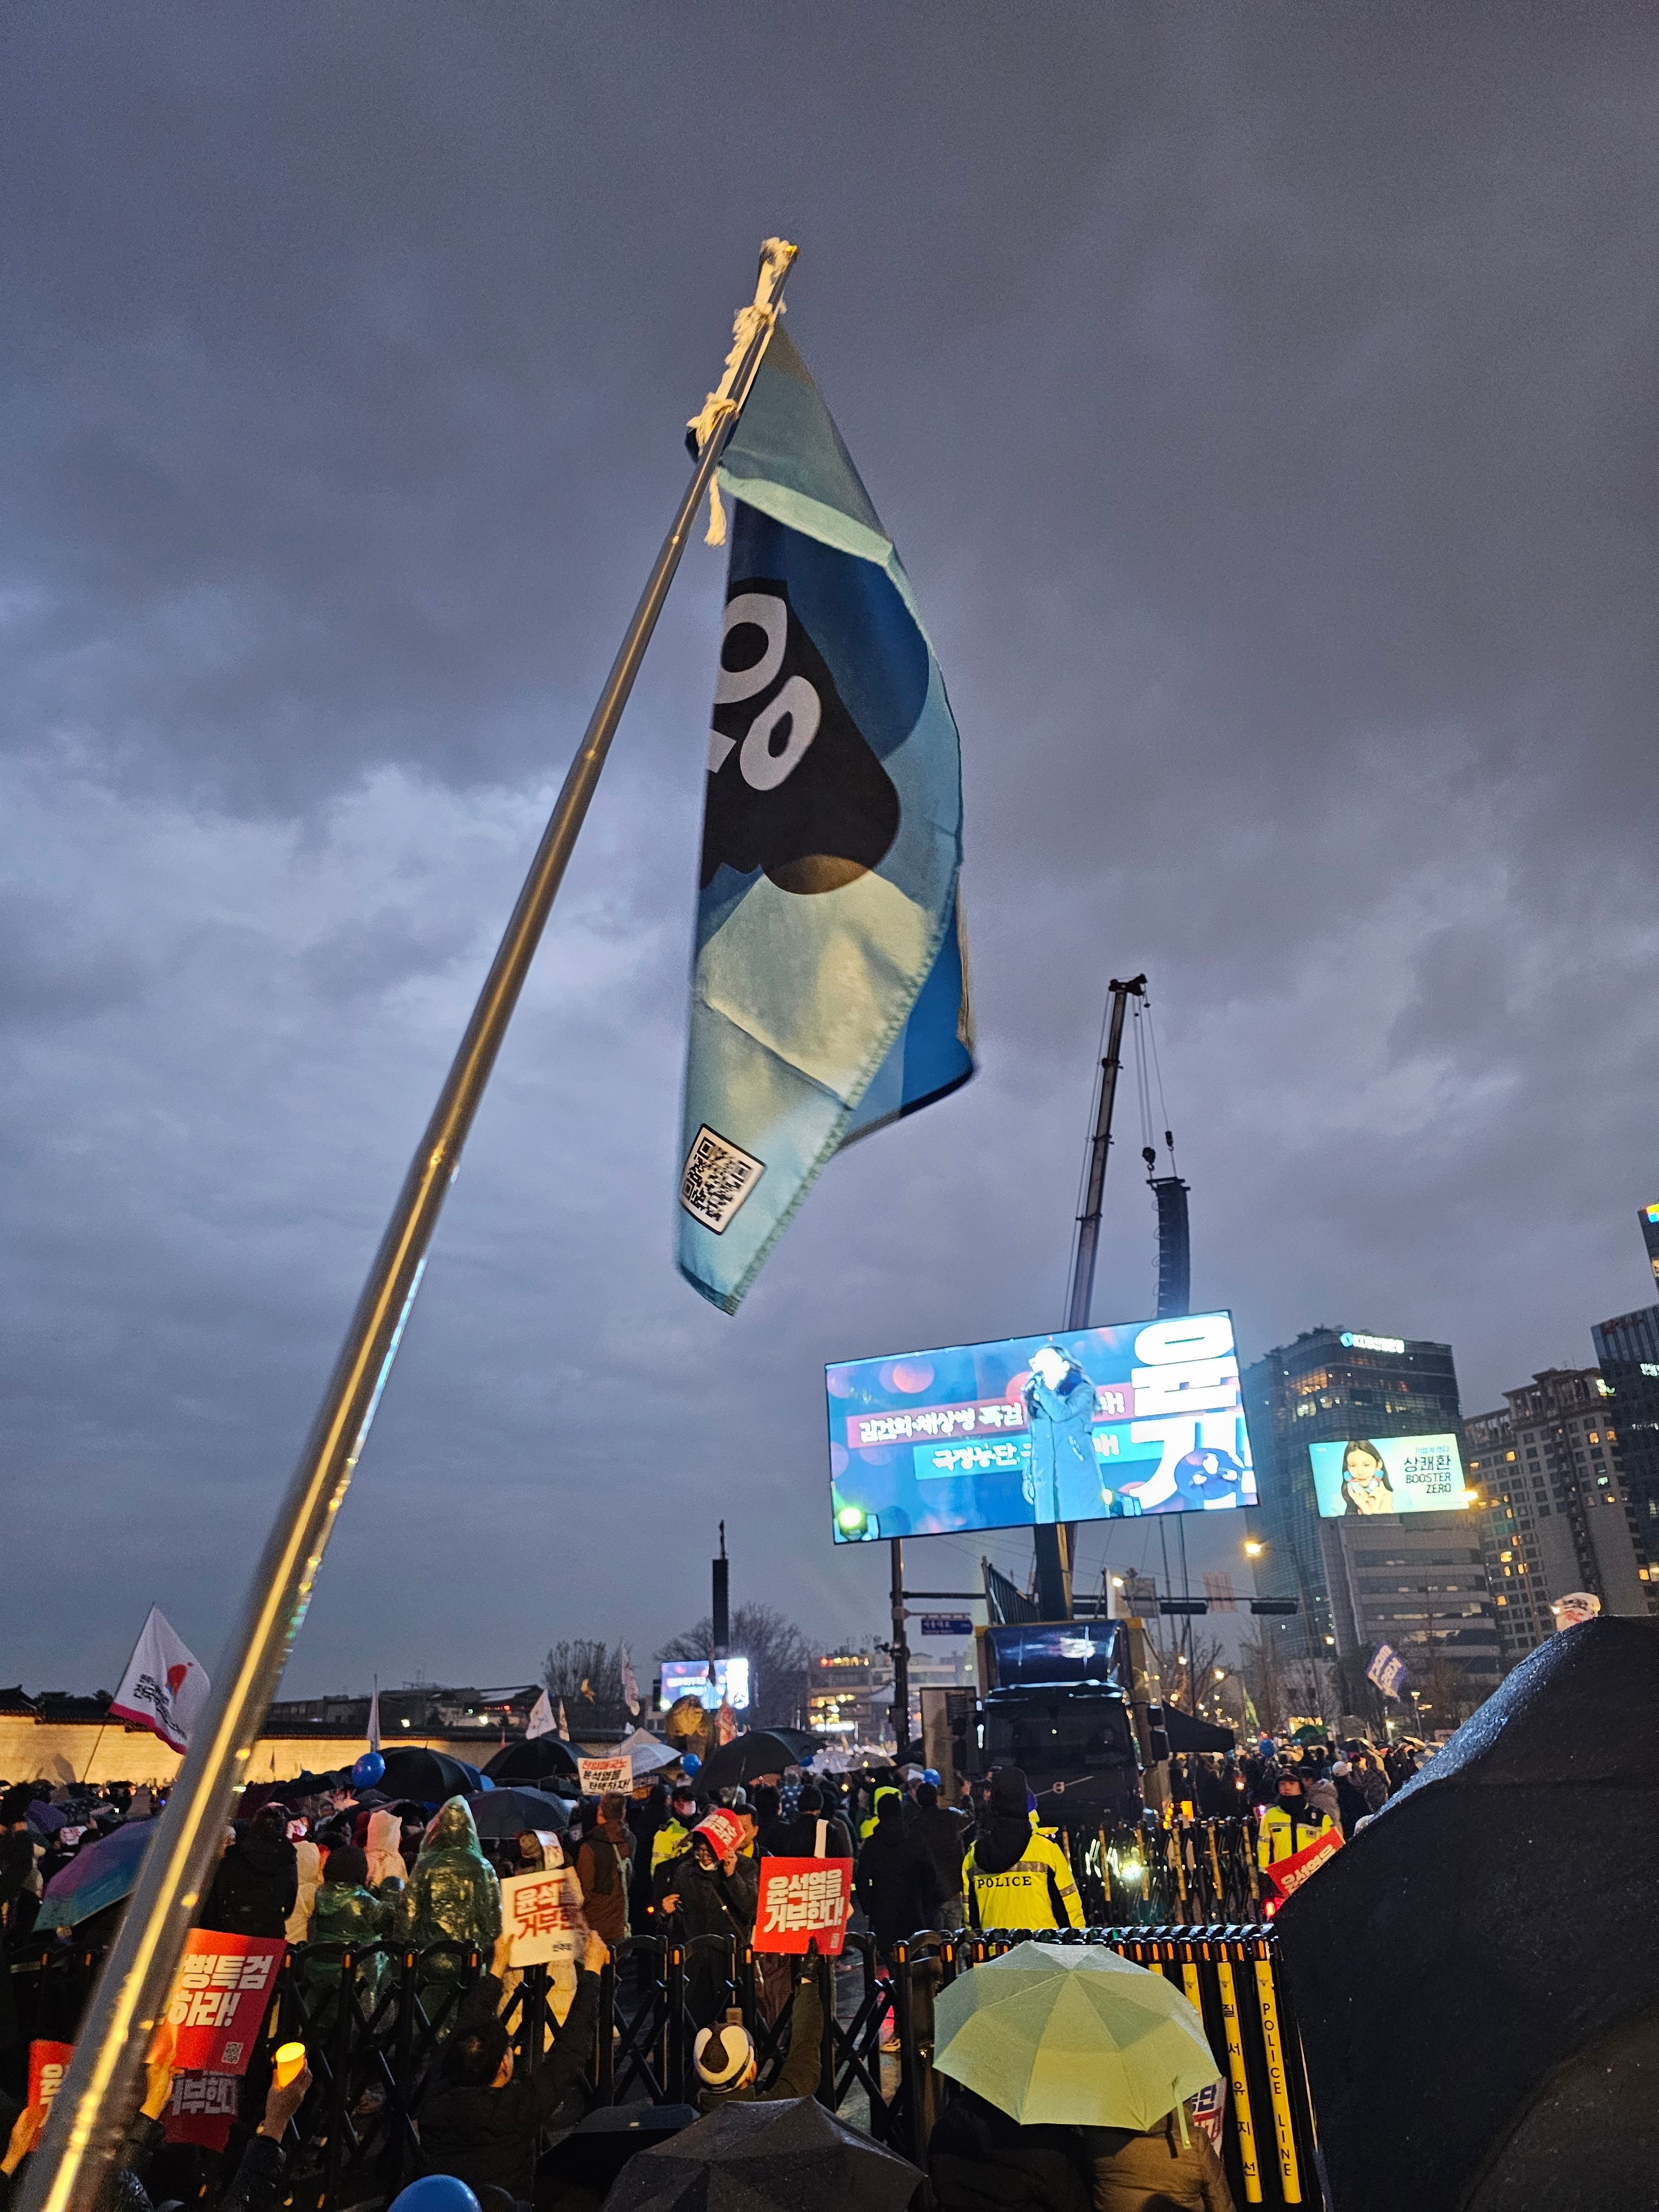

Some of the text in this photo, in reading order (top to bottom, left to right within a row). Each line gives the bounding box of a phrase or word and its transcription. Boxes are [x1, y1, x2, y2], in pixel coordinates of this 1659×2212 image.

[1406, 1472, 1451, 1484] BOOSTER
[1426, 1483, 1451, 1494] ZERO
[515, 1881, 561, 1918] 윤석
[768, 1869, 842, 1906] 윤석열을
[977, 1876, 1032, 1889] POLICE
[763, 1896, 844, 1933] 거부한다!
[180, 1954, 274, 1990] 병특검
[157, 1990, 242, 2027] 하라!
[1262, 2002, 1292, 2177] POLICE LINE
